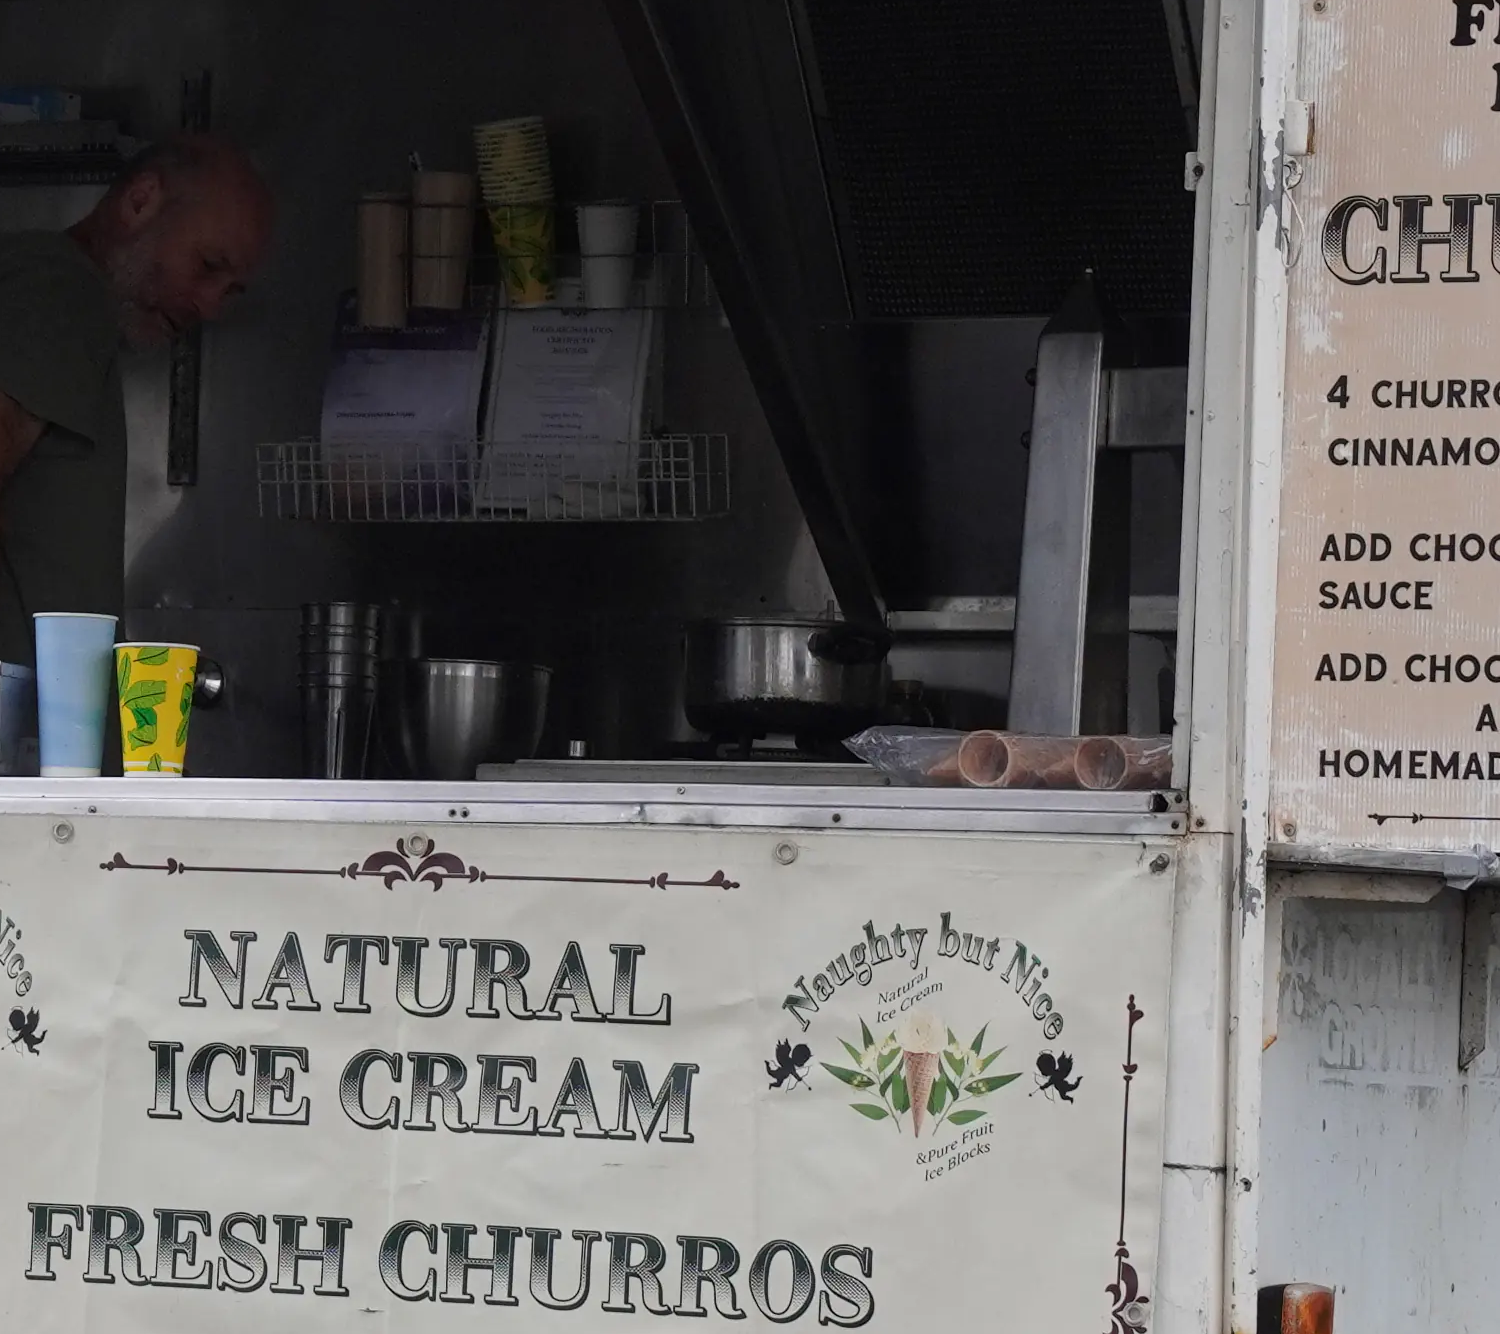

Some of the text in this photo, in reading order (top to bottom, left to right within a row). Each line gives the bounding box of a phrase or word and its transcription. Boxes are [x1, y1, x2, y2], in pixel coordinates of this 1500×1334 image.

[1327, 374, 1350, 408] 4
[1320, 533, 1393, 564] ADD
[1318, 581, 1433, 611] SAUCE
[1314, 654, 1388, 684] ADD
[181, 927, 674, 1027] NATURAL
[782, 911, 1064, 1040] Naughty but Nice
[878, 967, 929, 1005] Natural
[877, 981, 943, 1023] Ice Cream
[144, 1039, 702, 1144] ICE CREAM
[962, 1122, 994, 1146] Fruit
[924, 1142, 990, 1181] Ice Blocks
[23, 1200, 877, 1330] FRESH CHURROS
